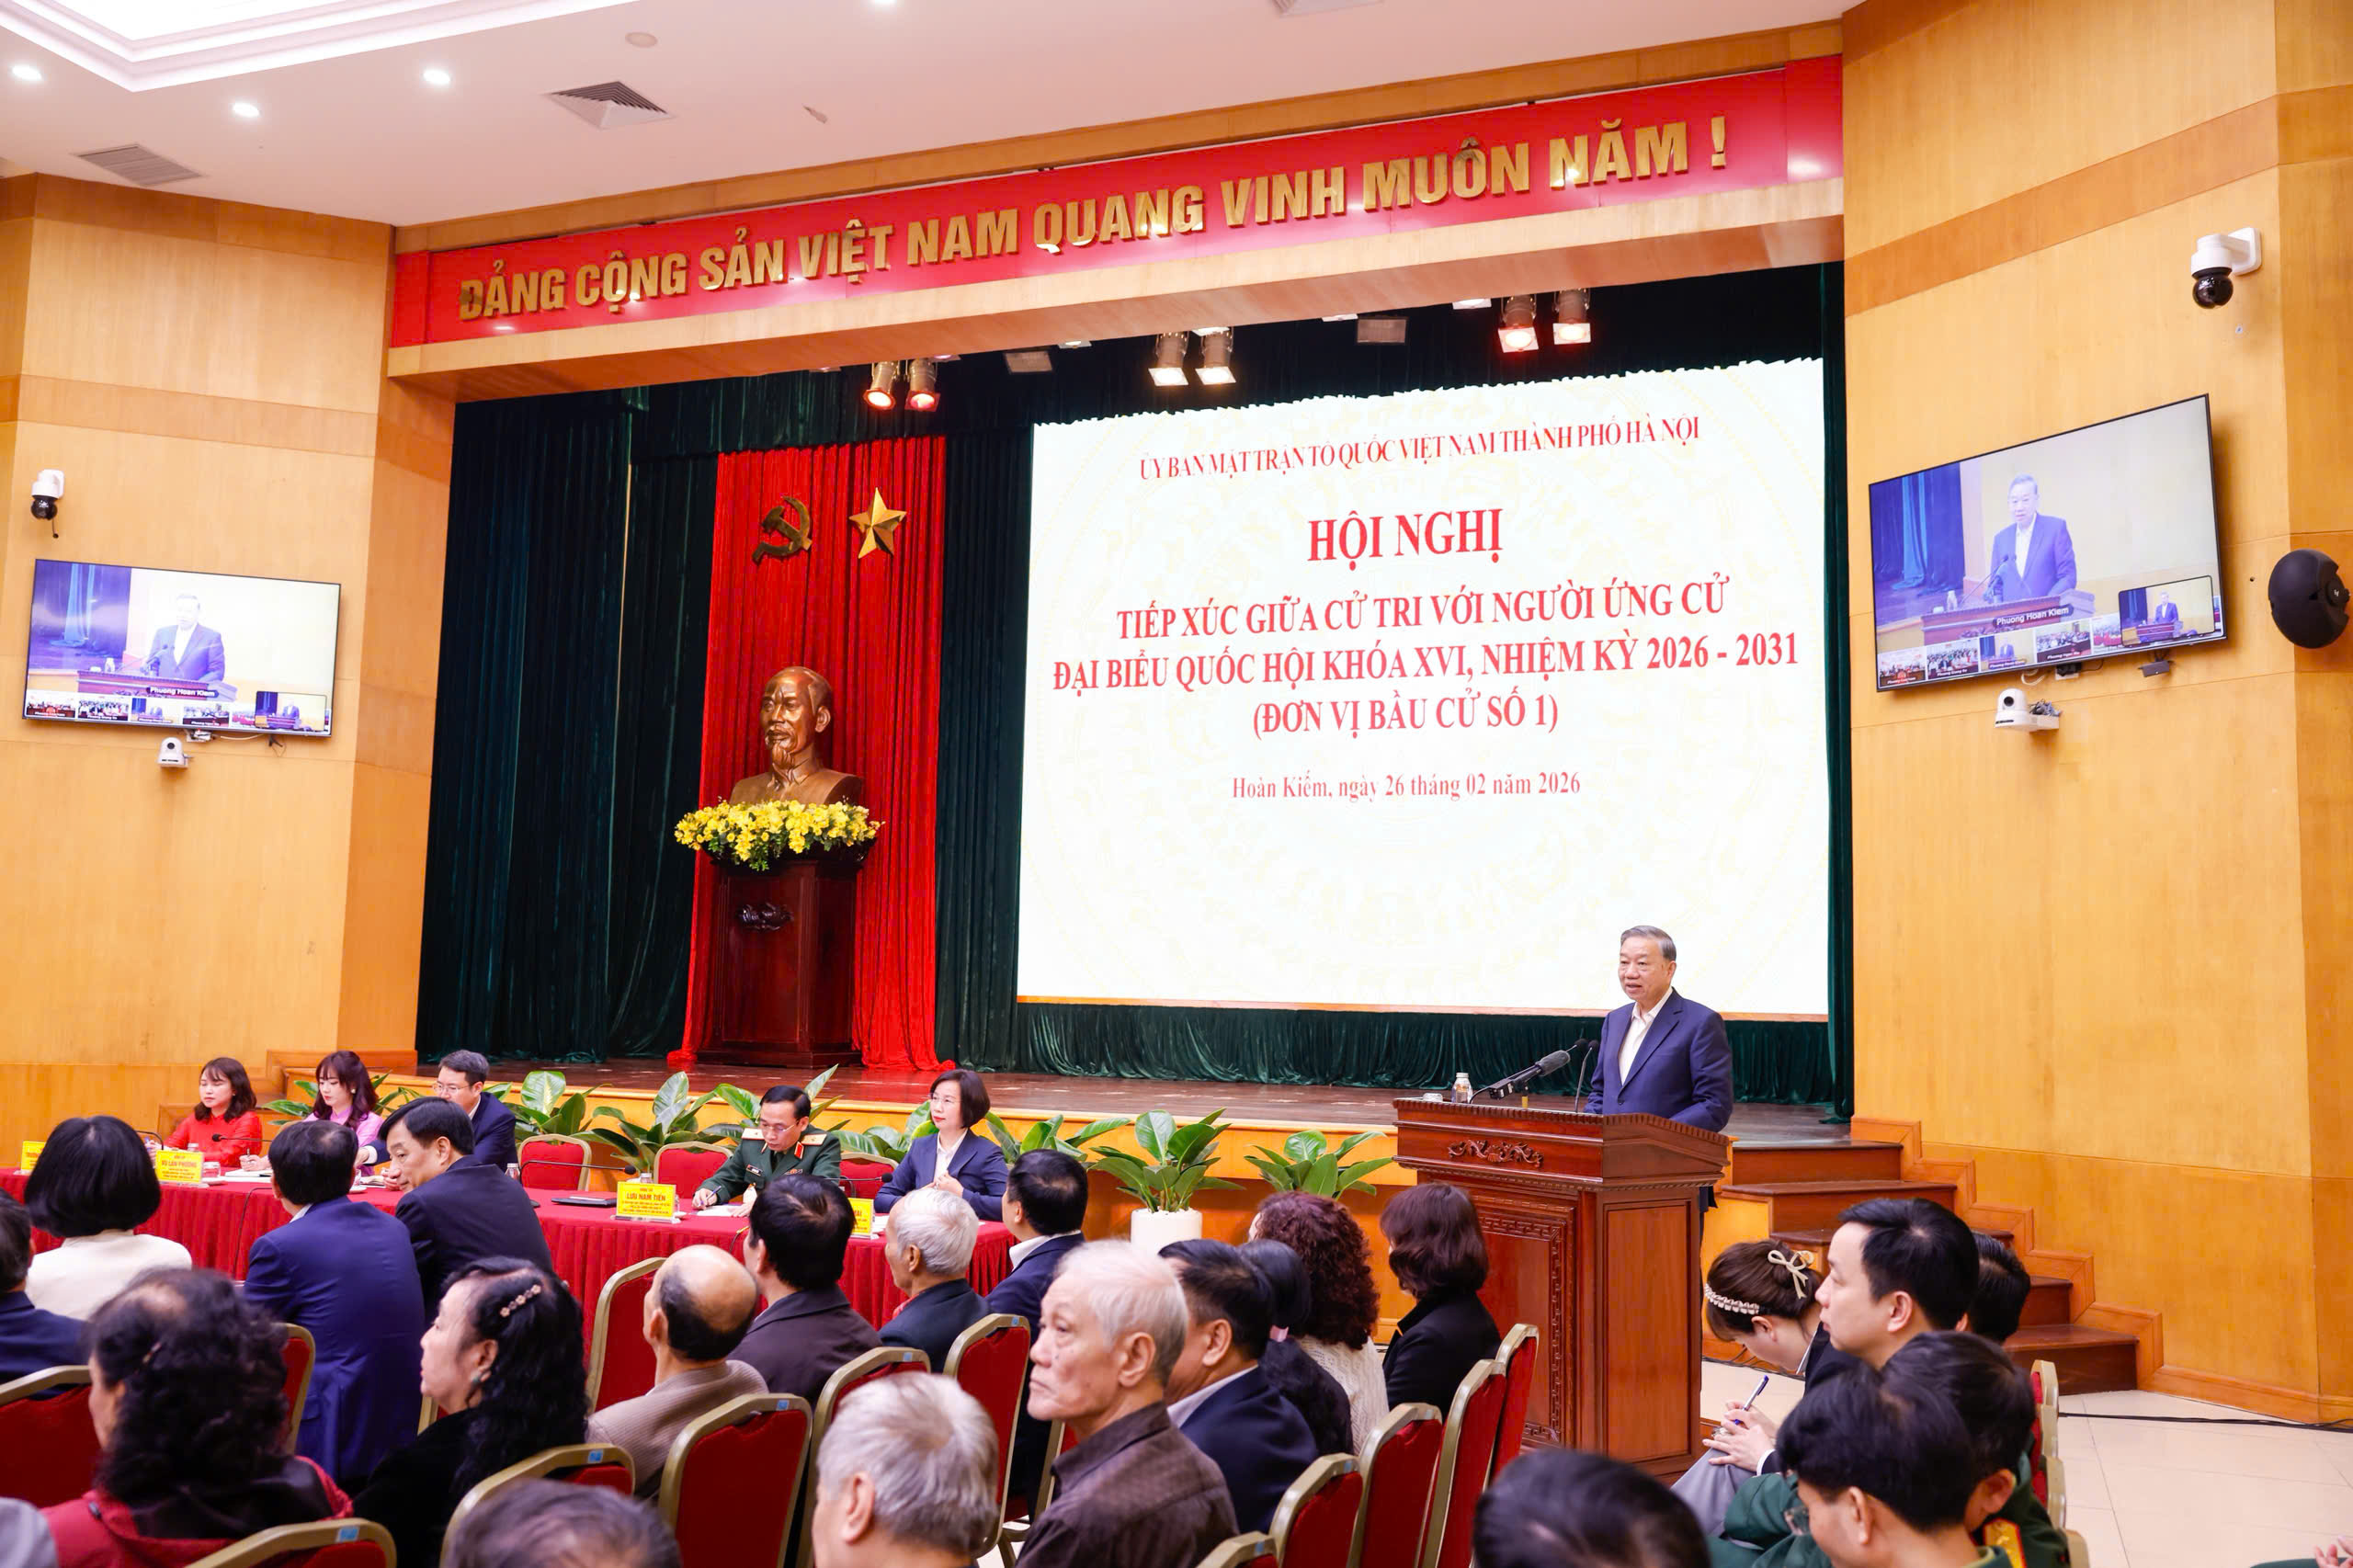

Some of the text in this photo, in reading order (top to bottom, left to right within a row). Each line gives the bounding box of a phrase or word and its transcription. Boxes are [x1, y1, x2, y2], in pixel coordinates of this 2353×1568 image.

[459, 259, 567, 321] ĐẢNG
[575, 250, 689, 313] CỘNG
[699, 227, 785, 291] SẢN
[798, 219, 894, 284] VIỆT
[907, 208, 1019, 267] NAM
[1033, 185, 1205, 255] QUANG
[1220, 165, 1346, 228] VINH
[1362, 137, 1529, 212] MUÔN
[1549, 118, 1688, 189] NĂM
[1168, 454, 1205, 478] BAN
[1398, 434, 1446, 464] VIỆT
[1449, 432, 1496, 457] NAM
[1499, 421, 1573, 453] THÀNH
[1576, 415, 1621, 447] PHỐ
[1625, 413, 1656, 444] HÀ
[1661, 413, 1699, 447] NỘI
[1307, 507, 1503, 572] HỘI NGHỊ
[1117, 571, 1731, 640] TIẾP XÚC GIỮA CỬ TRI VỚI NGƯỜI ỨNG CỬ
[1052, 659, 1100, 698] ĐẠI
[1106, 648, 1168, 688] BIỂU
[1176, 644, 1256, 693] QUỐC
[1262, 646, 1314, 690] HỘI
[1323, 639, 1408, 681] KHÓA
[1413, 644, 1473, 682] XVI,
[1481, 635, 1586, 682] NHIỆM
[1593, 628, 1639, 672] KỲ
[1646, 634, 1709, 670] 2026
[1735, 631, 1798, 666] 2031
[1253, 685, 1558, 739] (ĐƠN VỊ BẦU CỬ SỐ 1)
[1233, 769, 1581, 802] Hoàn Kiếm, ngày 26 tháng 02 năm 2026
